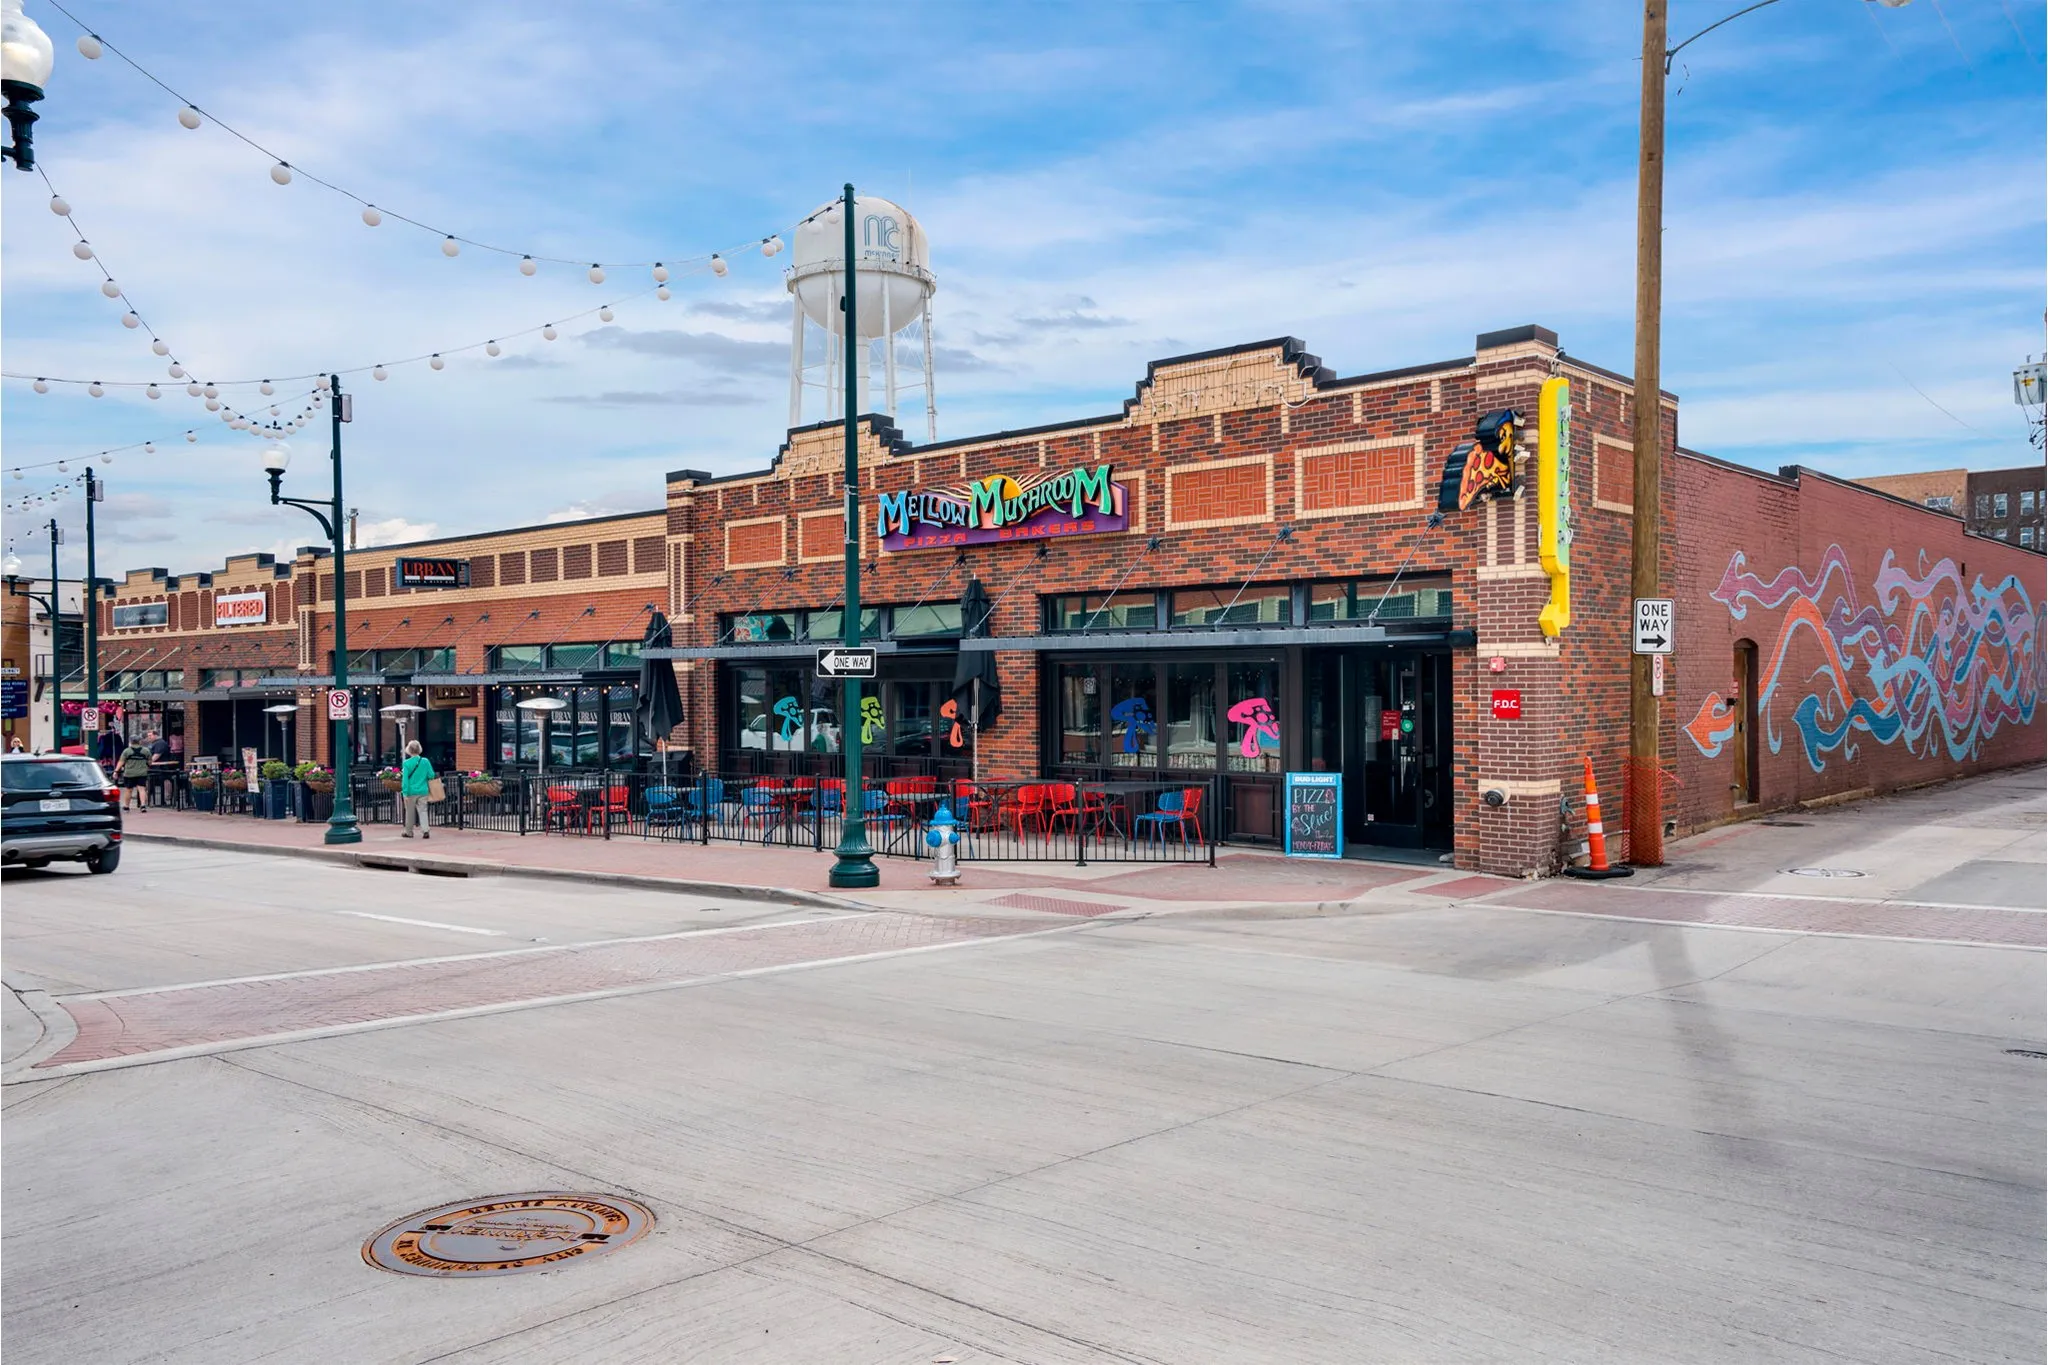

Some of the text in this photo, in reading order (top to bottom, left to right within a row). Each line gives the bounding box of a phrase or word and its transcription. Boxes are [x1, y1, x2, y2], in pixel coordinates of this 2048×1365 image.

[878, 464, 1114, 538] MELLOW MUSHROOM
[903, 520, 1097, 548] PIZZA BAKERS
[404, 562, 455, 580] URBAN
[217, 599, 264, 620] FILTERED
[1641, 603, 1668, 617] ONE
[1640, 619, 1669, 631] WAY
[834, 657, 869, 668] ONE WAY
[1494, 700, 1519, 708] F.D.C.
[1292, 804, 1316, 813] BY THE
[542, 1248, 584, 1264] CITY
[497, 1260, 525, 1270] OF
